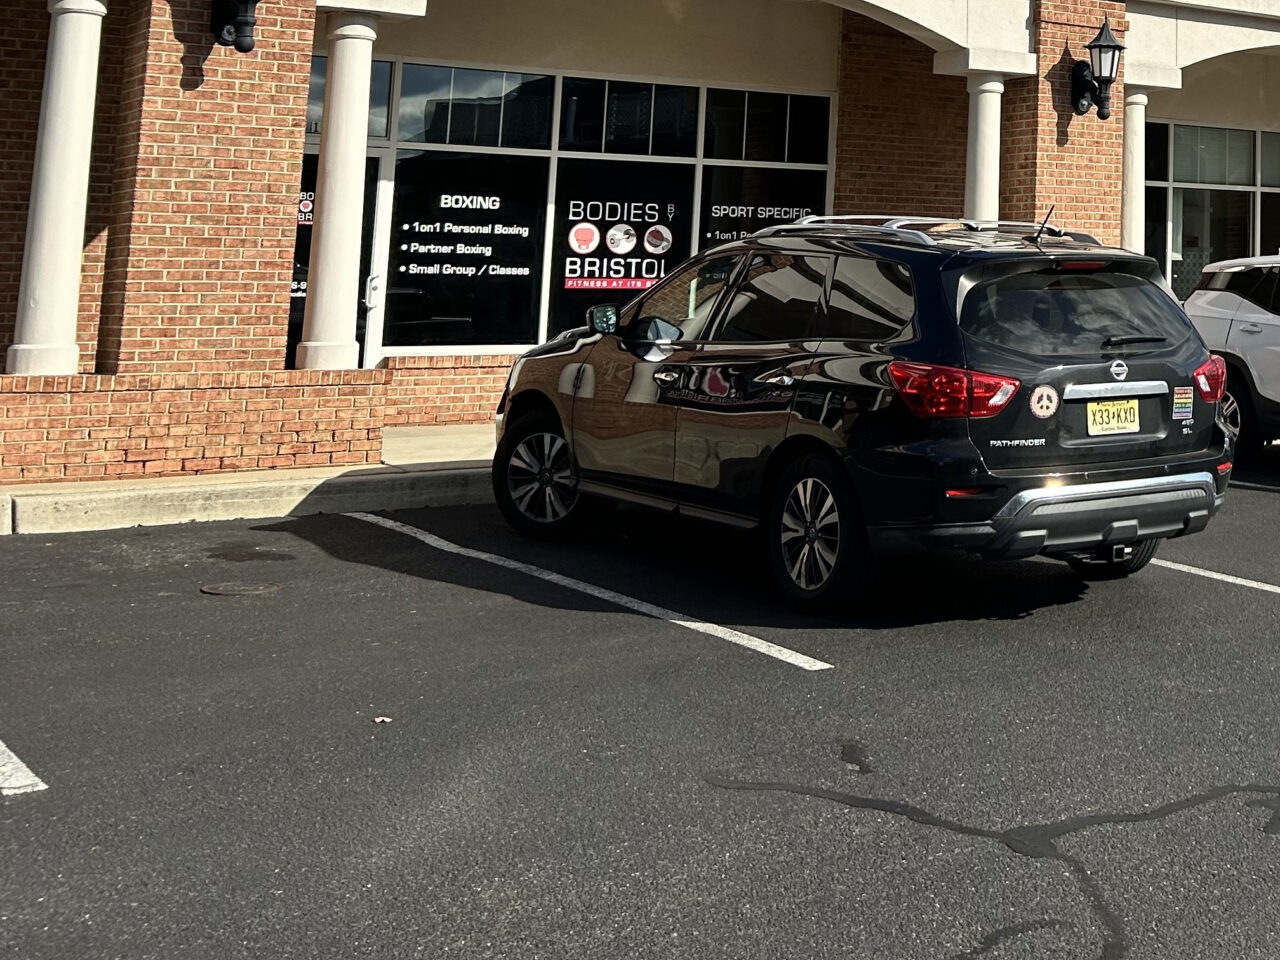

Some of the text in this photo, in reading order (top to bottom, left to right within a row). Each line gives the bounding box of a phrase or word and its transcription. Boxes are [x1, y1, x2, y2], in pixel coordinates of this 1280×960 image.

[440, 194, 501, 210] BOXING
[568, 200, 659, 222] BODIES
[711, 205, 755, 218] SPORT
[413, 222, 529, 238] 1on1 Personal Boxing
[714, 230, 737, 240] 1on1
[410, 242, 493, 257] Partner Boxing
[408, 263, 440, 275] Small
[442, 264, 477, 277] Group
[488, 265, 530, 276] Classes
[567, 280, 608, 288] FITNESS
[611, 280, 622, 288] AT
[627, 280, 642, 288] ITS
[990, 438, 1046, 447] PATHFINDER
